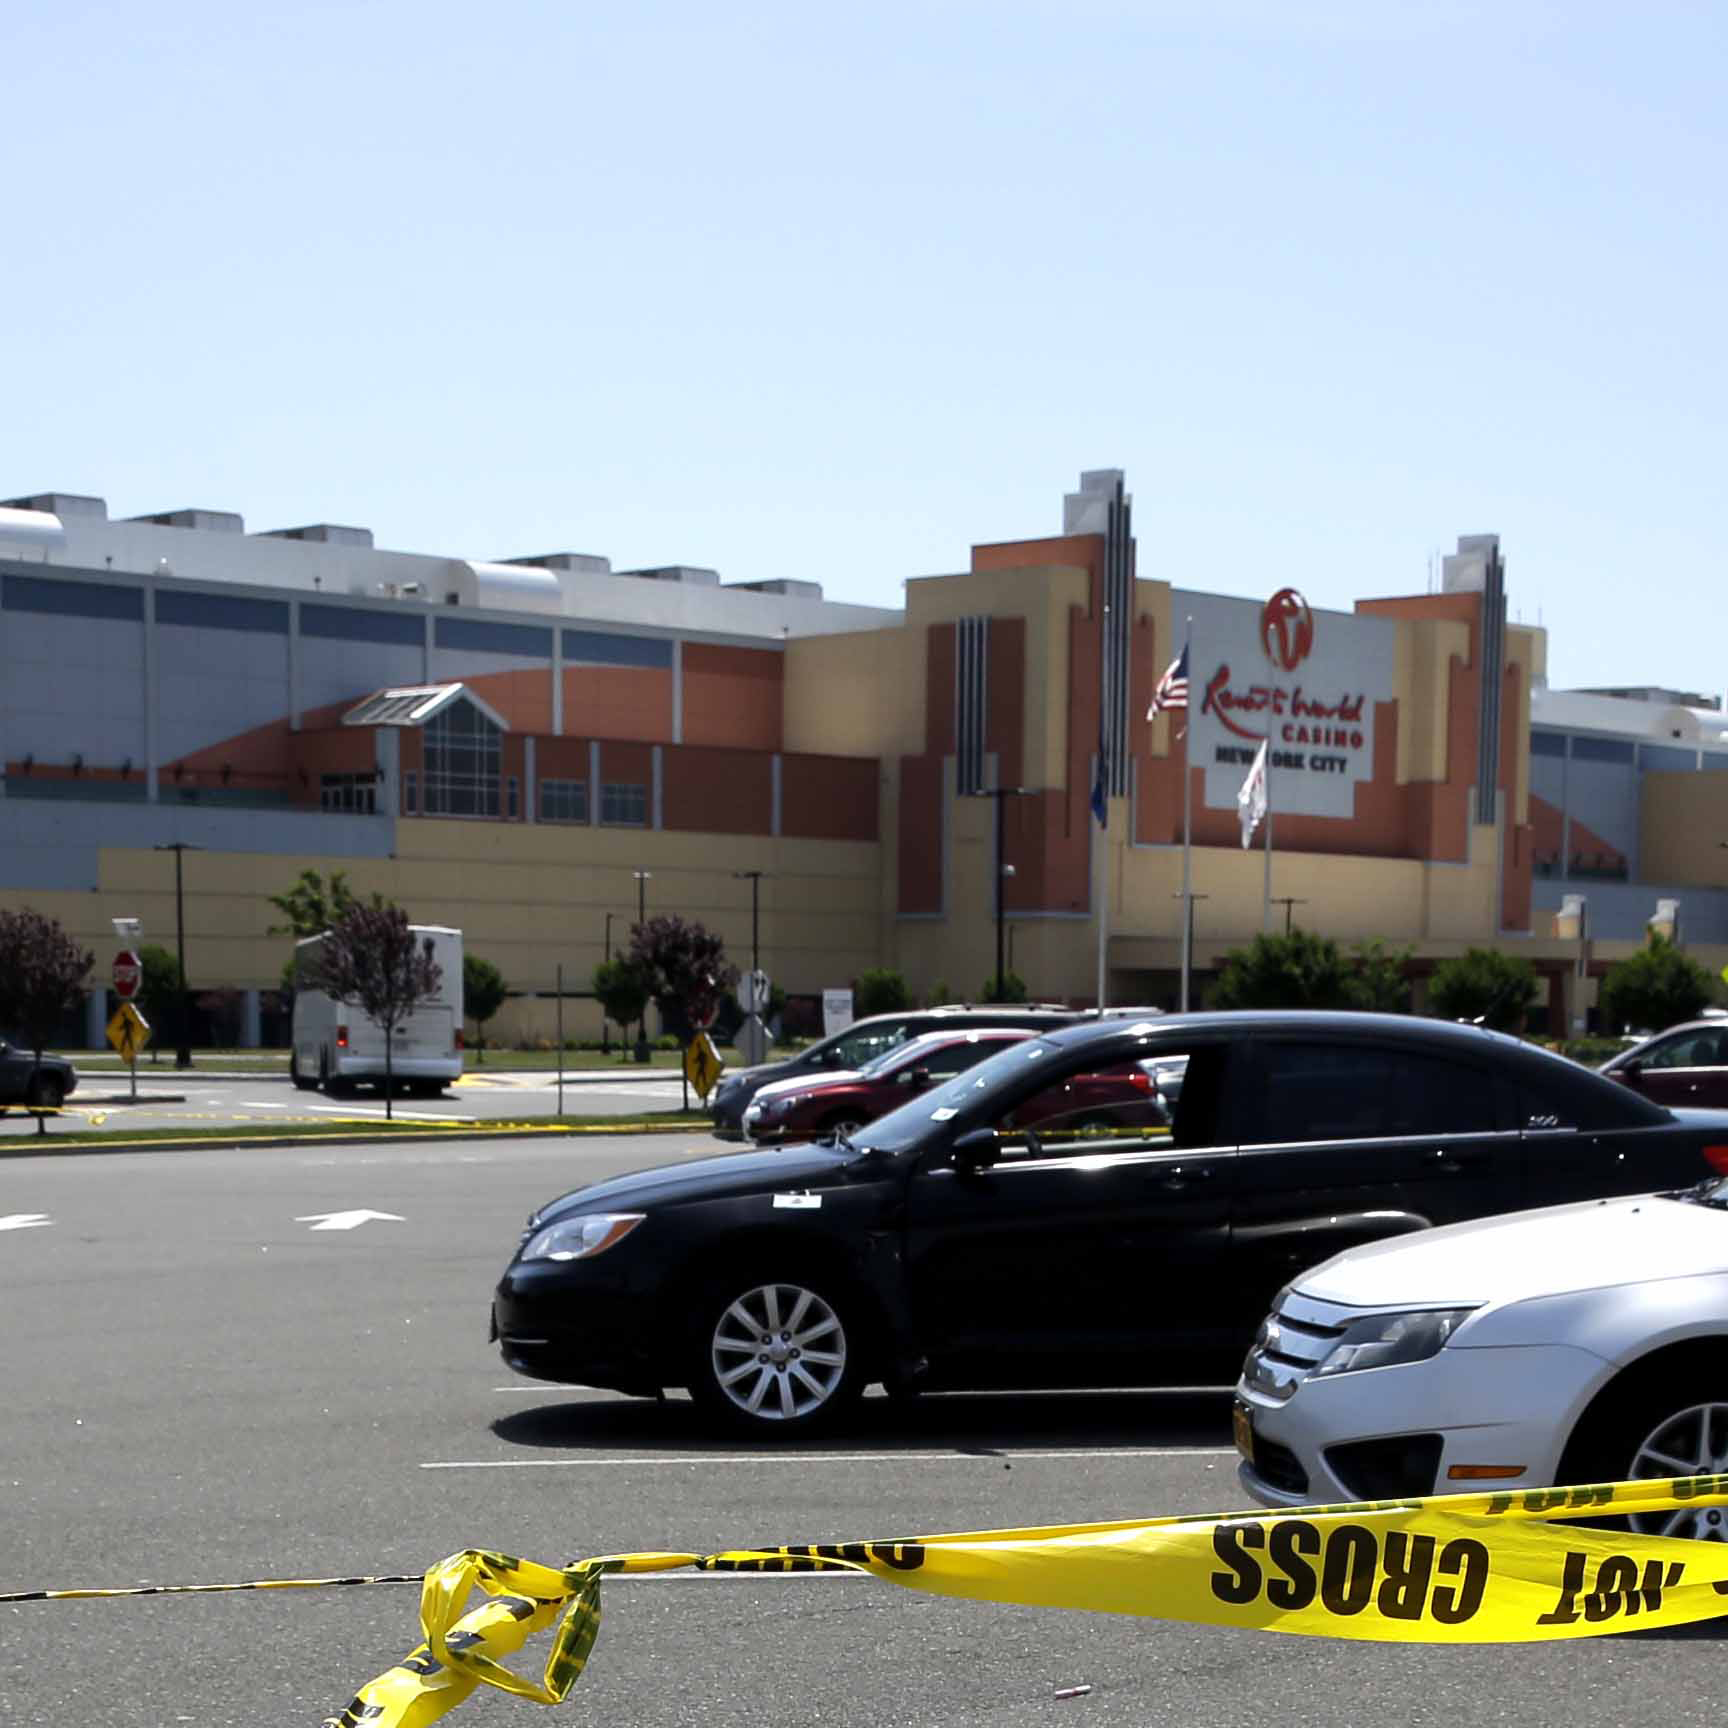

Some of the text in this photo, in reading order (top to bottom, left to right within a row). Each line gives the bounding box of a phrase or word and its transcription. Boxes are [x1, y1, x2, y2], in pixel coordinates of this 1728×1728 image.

[1282, 724, 1364, 749] CASINO
[1310, 755, 1347, 773] CITY
[1210, 1520, 1489, 1626] CROSS
[1536, 1548, 1685, 1626] NOT
